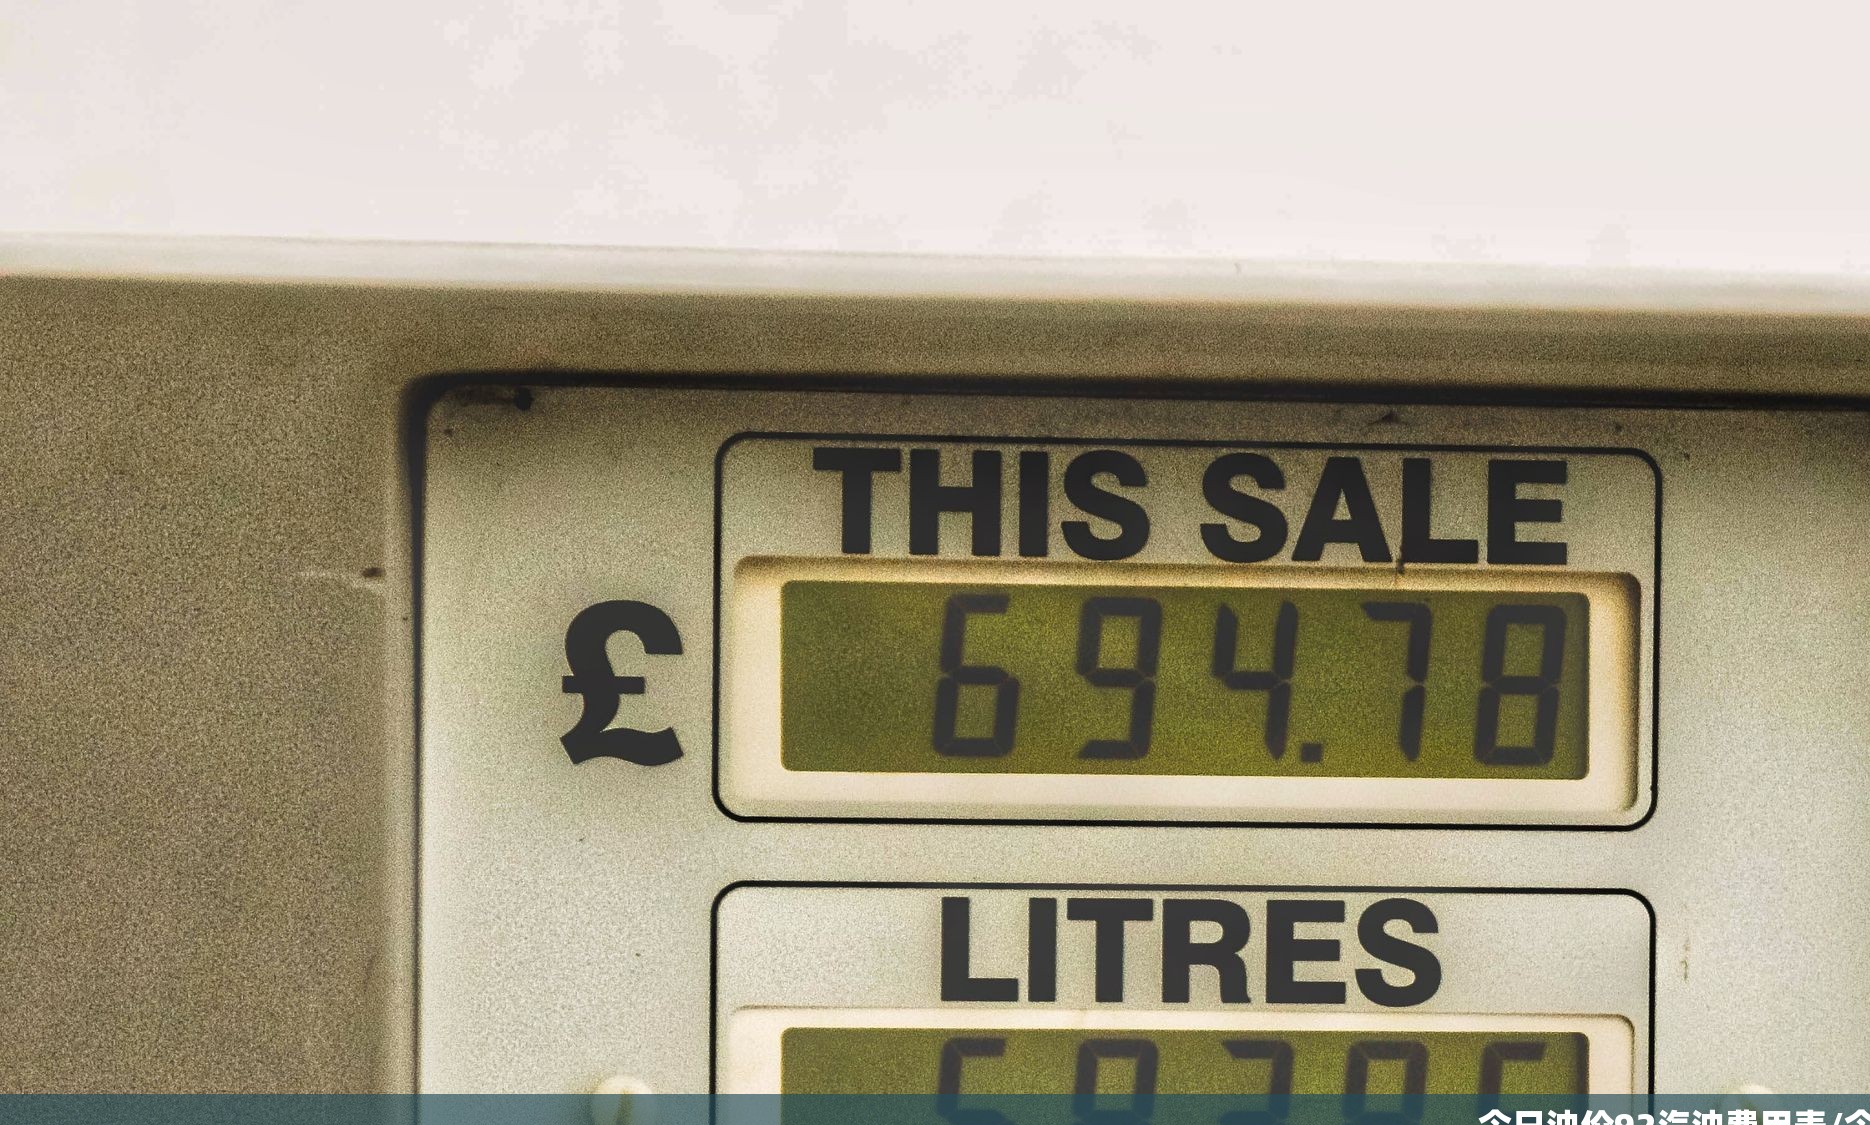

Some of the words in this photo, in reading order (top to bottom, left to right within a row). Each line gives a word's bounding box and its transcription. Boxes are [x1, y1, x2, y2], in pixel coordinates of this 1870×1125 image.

[812, 447, 1150, 561] THIS
[1200, 451, 1569, 566] SALE
[558, 599, 684, 766] £
[939, 895, 1443, 1007] LITRES
